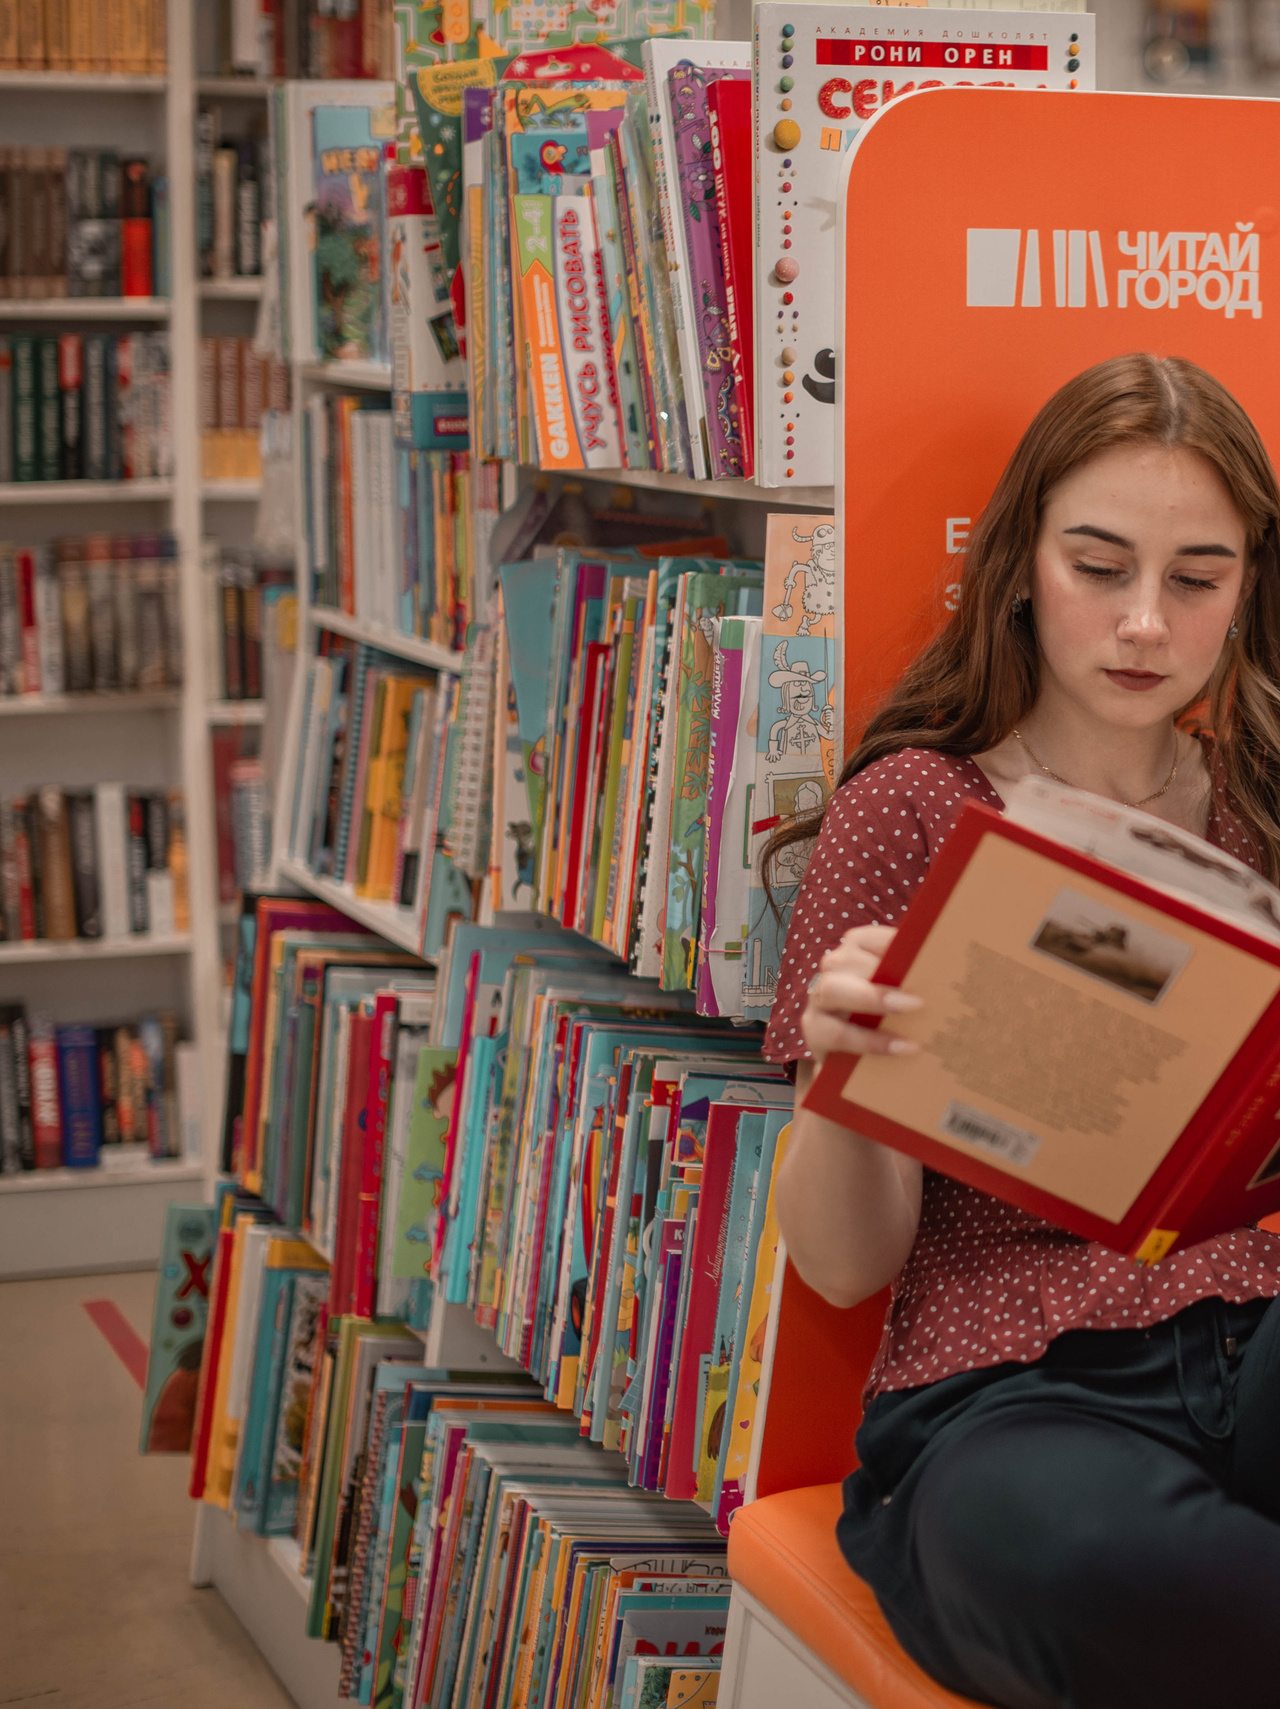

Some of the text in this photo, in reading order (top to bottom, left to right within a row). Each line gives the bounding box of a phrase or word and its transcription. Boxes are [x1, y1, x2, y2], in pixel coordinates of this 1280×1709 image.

[815, 26, 1048, 40] АКАДЕМИЯ ДОШКОЛЯТ
[854, 45, 1013, 66] РОНИ ОРЕН
[1117, 221, 1260, 272] ЧИТАЙ
[1117, 269, 1263, 319] ГОРОД
[559, 208, 607, 450] УЧУСЬ РИСОВАТЬ
[539, 352, 570, 460] GAKKEN
